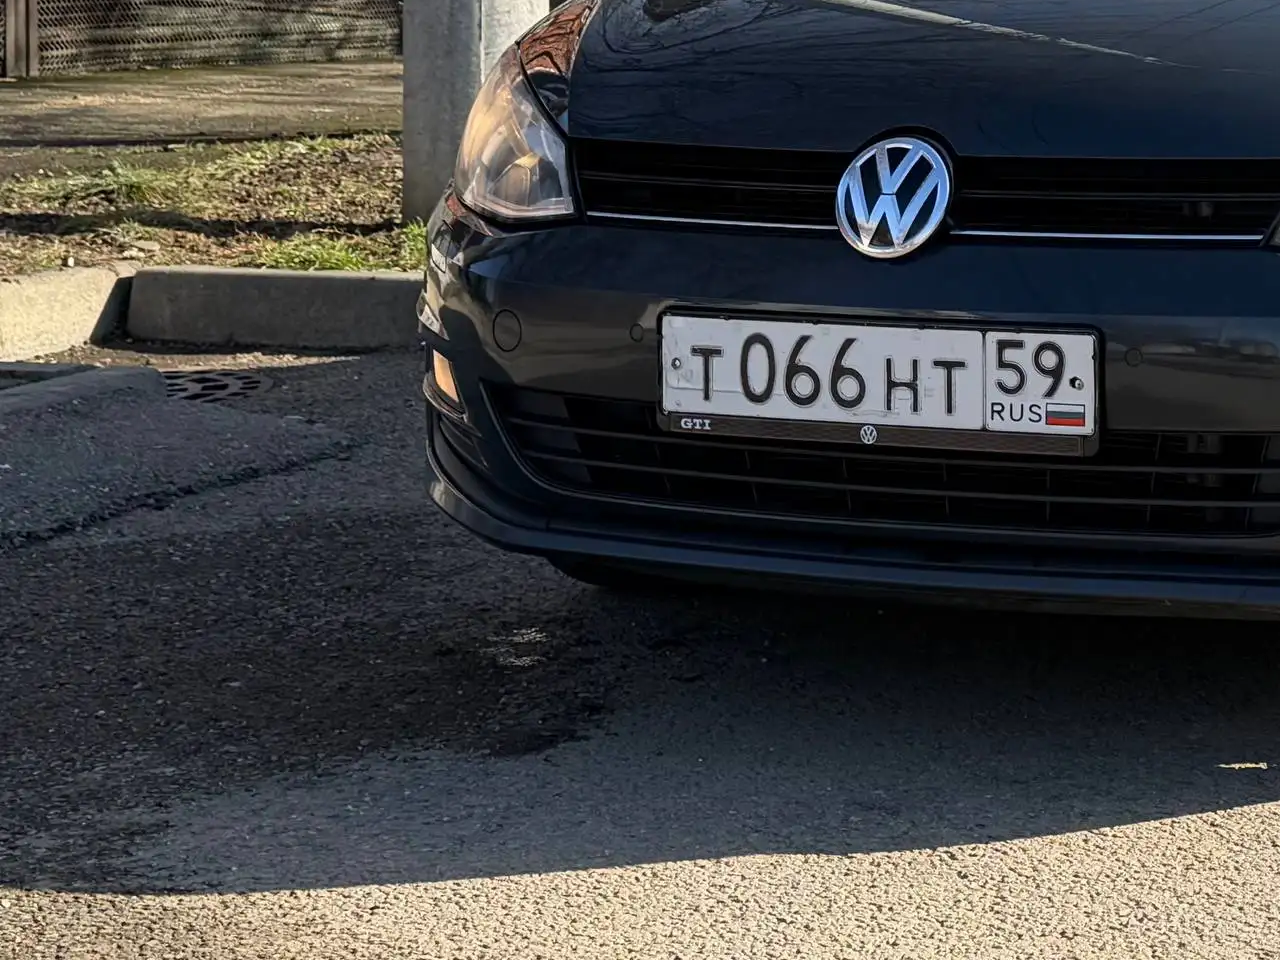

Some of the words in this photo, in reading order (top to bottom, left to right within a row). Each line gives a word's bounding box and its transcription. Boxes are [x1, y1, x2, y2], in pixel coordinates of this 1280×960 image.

[995, 339, 1066, 398] 59
[990, 402, 1042, 423] RUS
[680, 418, 712, 430] GTI
